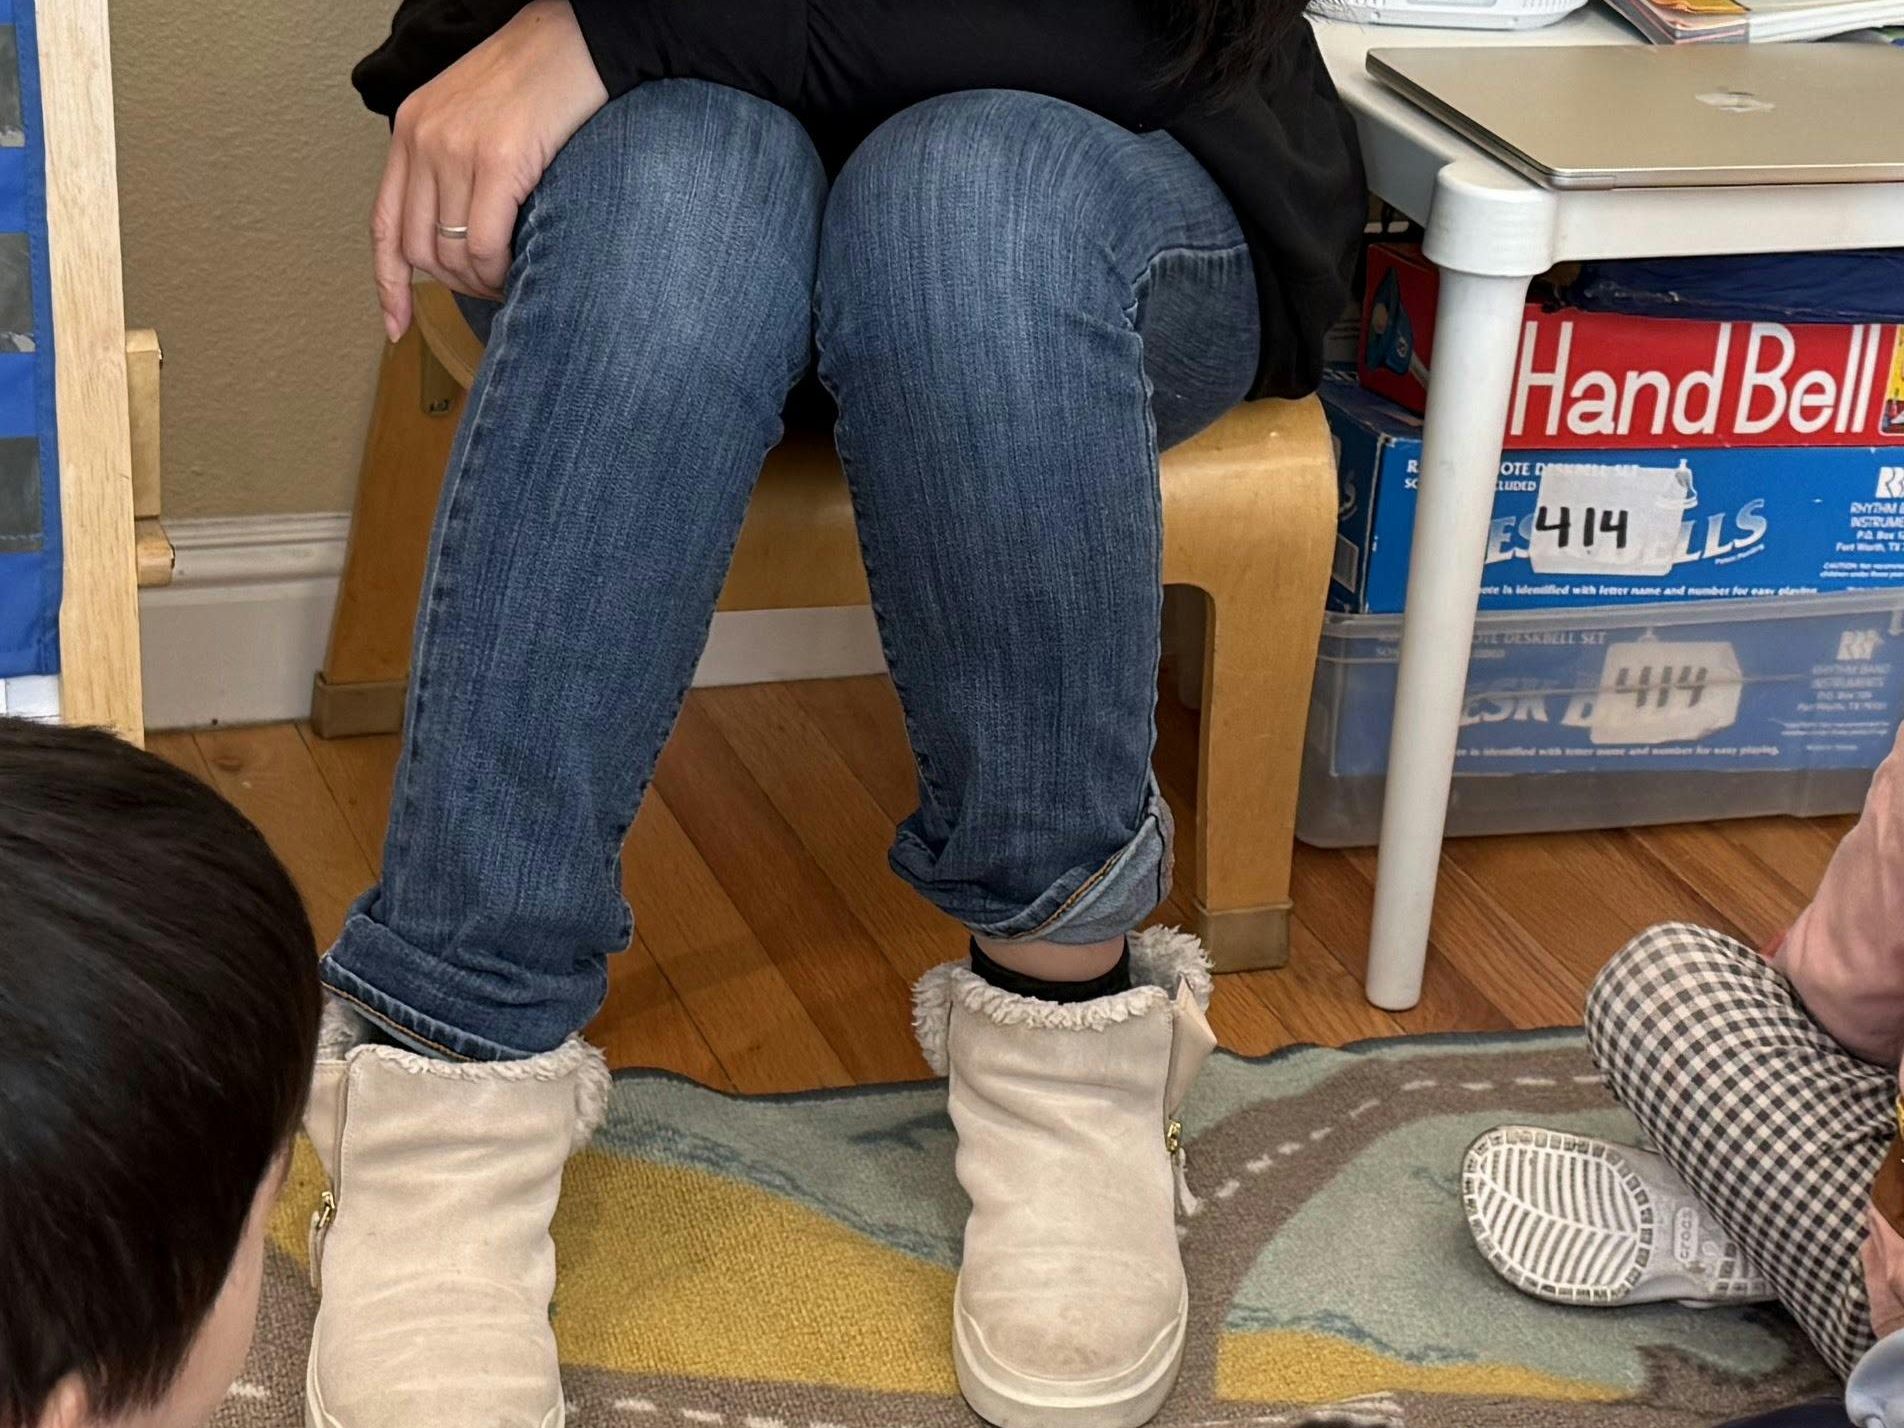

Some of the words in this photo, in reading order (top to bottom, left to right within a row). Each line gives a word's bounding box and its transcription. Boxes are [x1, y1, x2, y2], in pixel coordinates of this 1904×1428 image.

[1501, 462, 1531, 476] OTE
[1850, 502, 1898, 515] RHYTHM
[1535, 506, 1629, 550] 414
[1876, 530, 1894, 540] Box
[1836, 542, 1856, 552] Fort
[1515, 584, 1570, 595] identified
[1572, 585, 1597, 595] with
[1599, 585, 1629, 595] letter
[1630, 587, 1661, 596] name
[1664, 586, 1685, 596] and
[1687, 586, 1729, 596] number
[1732, 586, 1748, 596] for
[1615, 666, 1708, 709] 414
[1679, 1208, 1693, 1260] crocs
